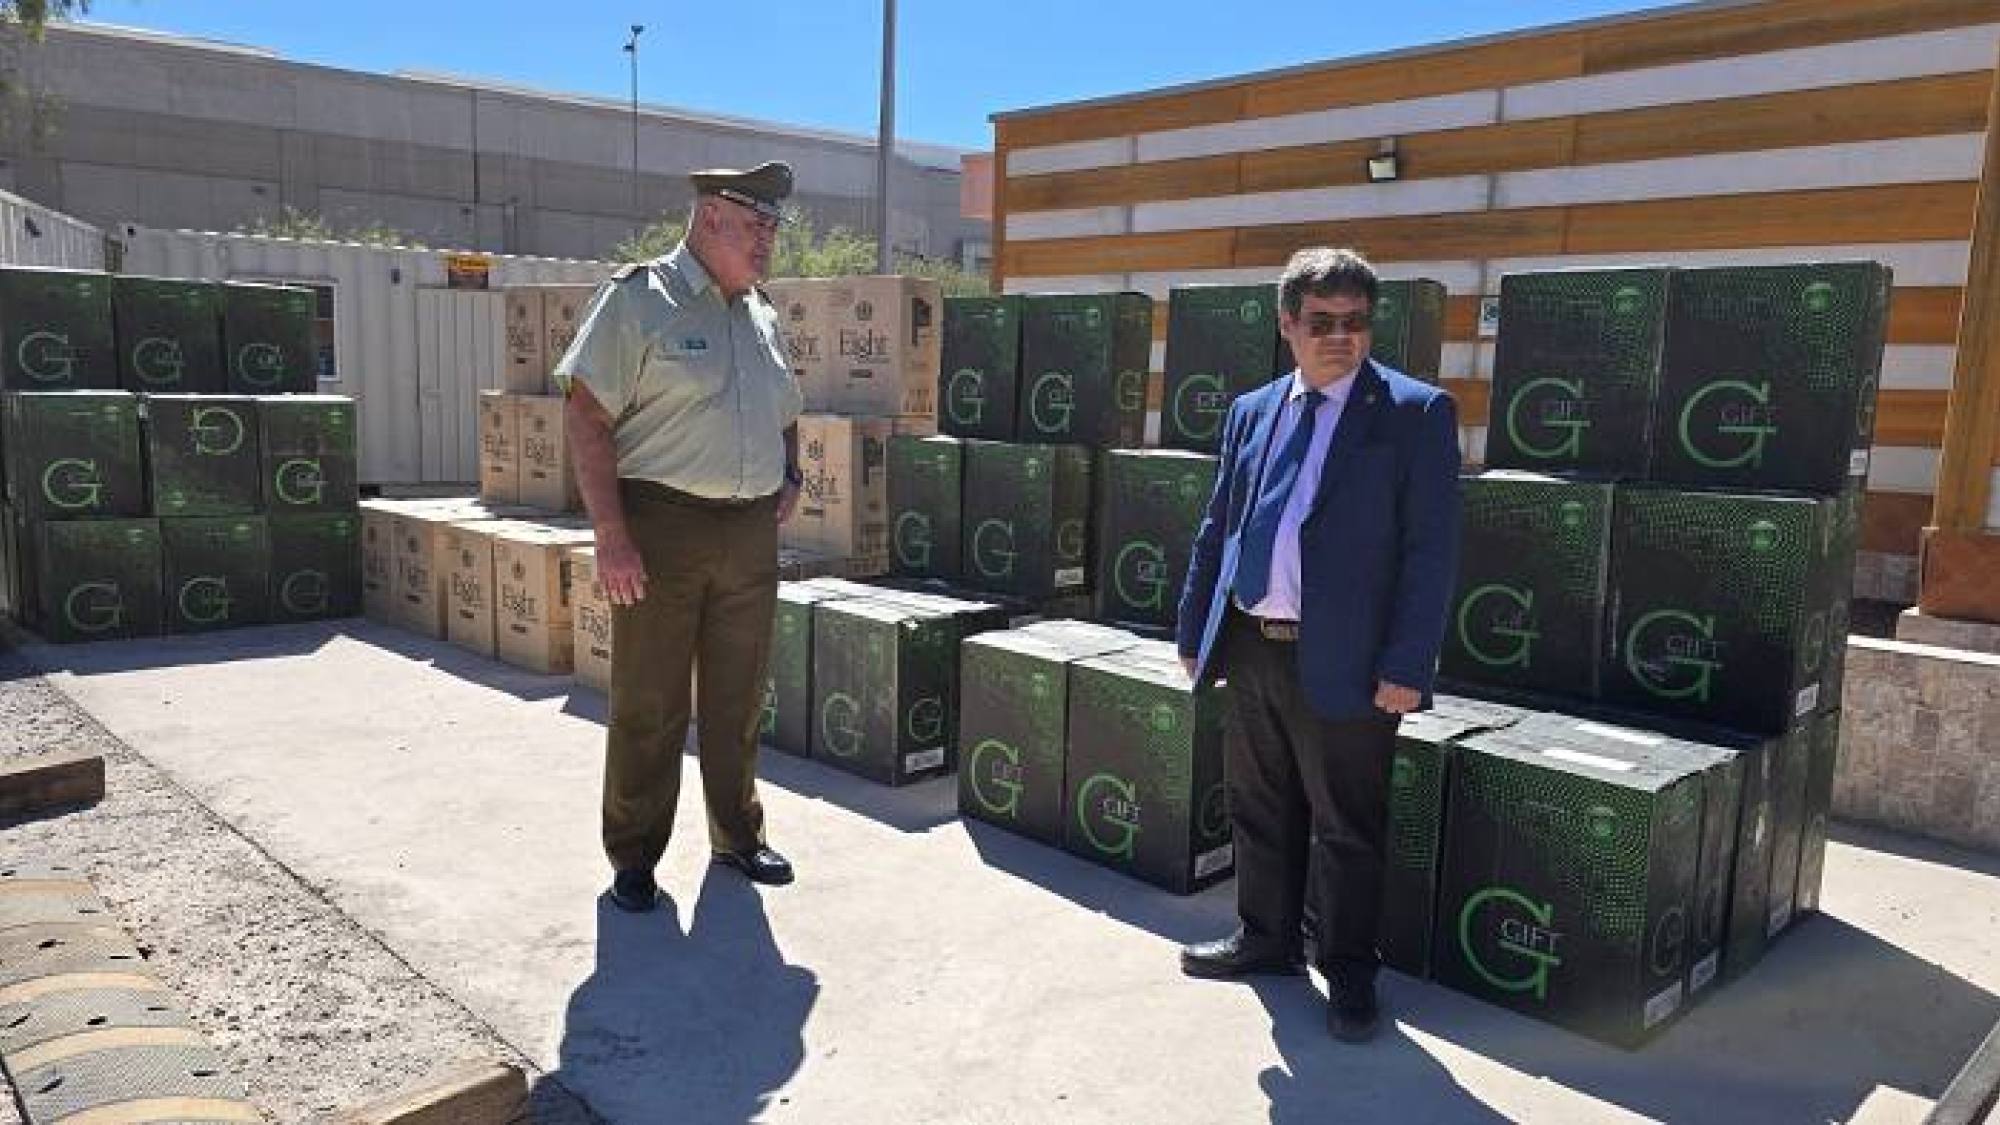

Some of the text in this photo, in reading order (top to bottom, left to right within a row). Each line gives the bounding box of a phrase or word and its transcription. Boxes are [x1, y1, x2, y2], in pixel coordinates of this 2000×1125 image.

[1031, 373, 1075, 432] G
[1507, 377, 1591, 458] G
[1679, 380, 1777, 468] G
[43, 458, 102, 507] G
[276, 459, 327, 504] G
[975, 519, 1016, 576] G
[1115, 541, 1169, 610] G
[179, 576, 230, 622] G
[1459, 584, 1541, 668] G
[1626, 609, 1724, 701] G
[823, 692, 865, 757] G
[972, 740, 1024, 817] G
[1078, 774, 1140, 859] G
[1460, 888, 1562, 1000] G
[1502, 918, 1568, 955] GIFT
